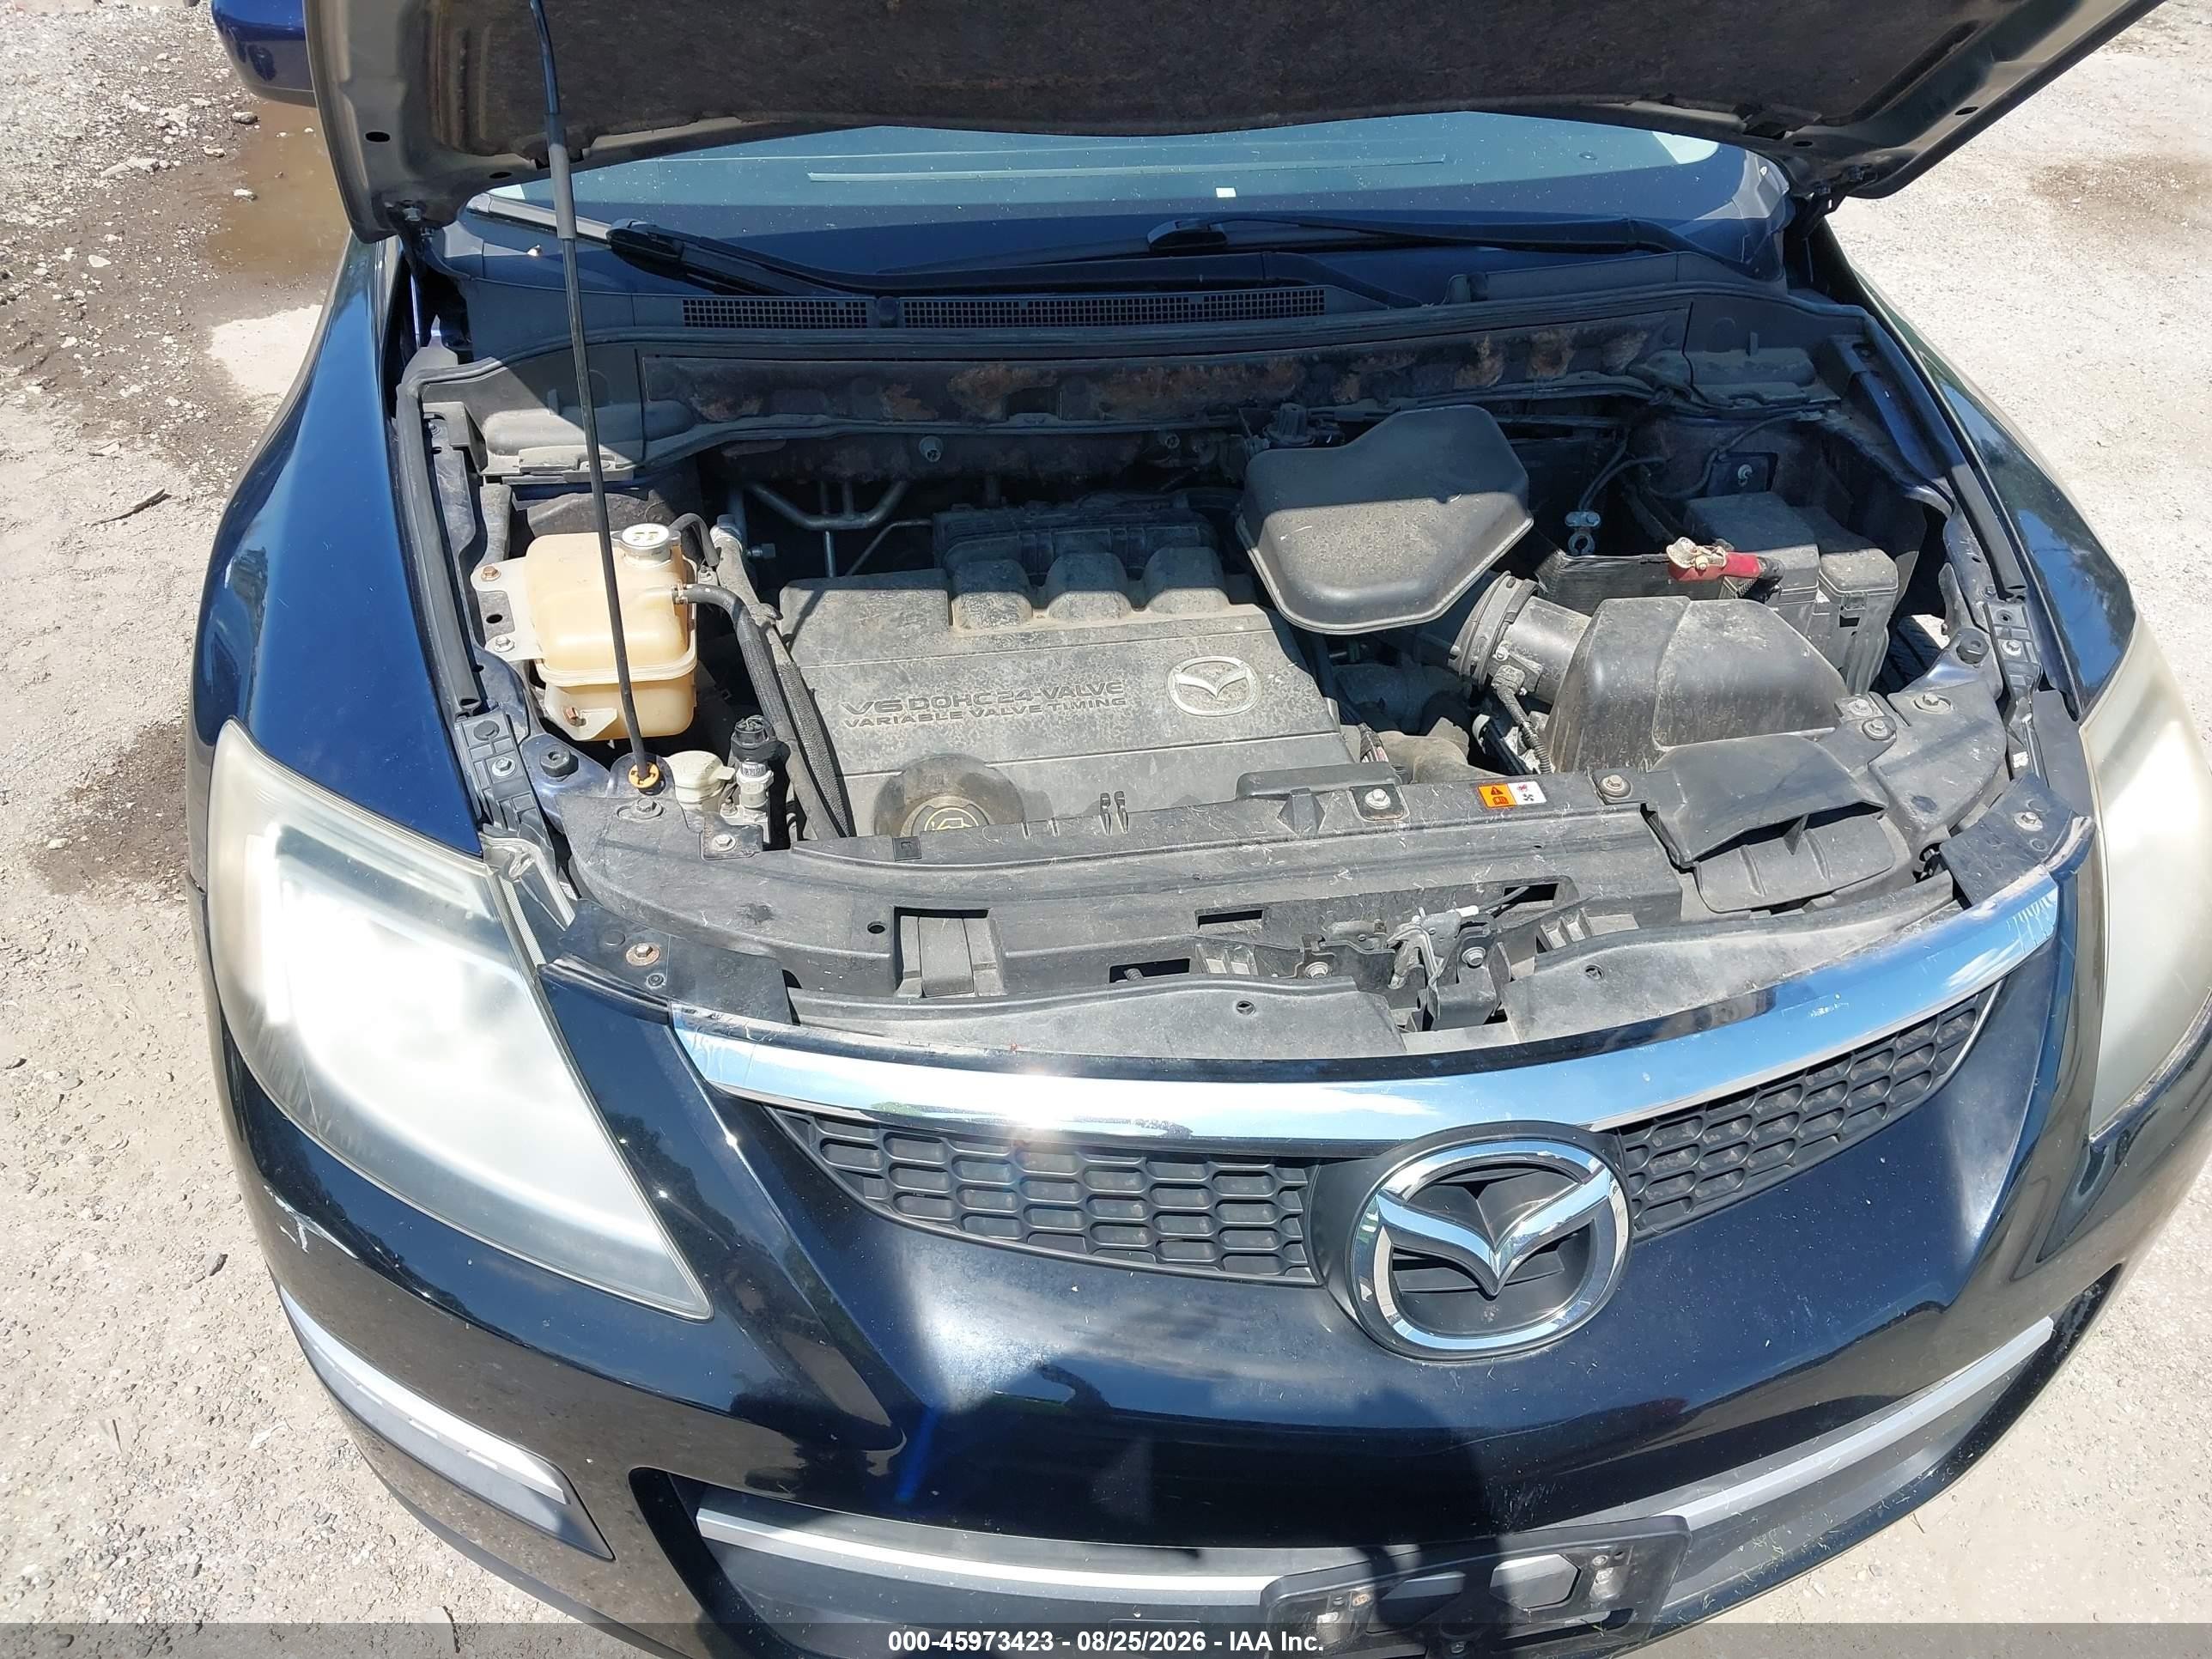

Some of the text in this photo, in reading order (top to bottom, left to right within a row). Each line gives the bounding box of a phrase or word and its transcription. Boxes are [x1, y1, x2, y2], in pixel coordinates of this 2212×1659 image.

[841, 681, 1124, 715] V6 DOHC 24-VALVE
[844, 697, 1127, 728] VARIABLE VALVE TIMING
